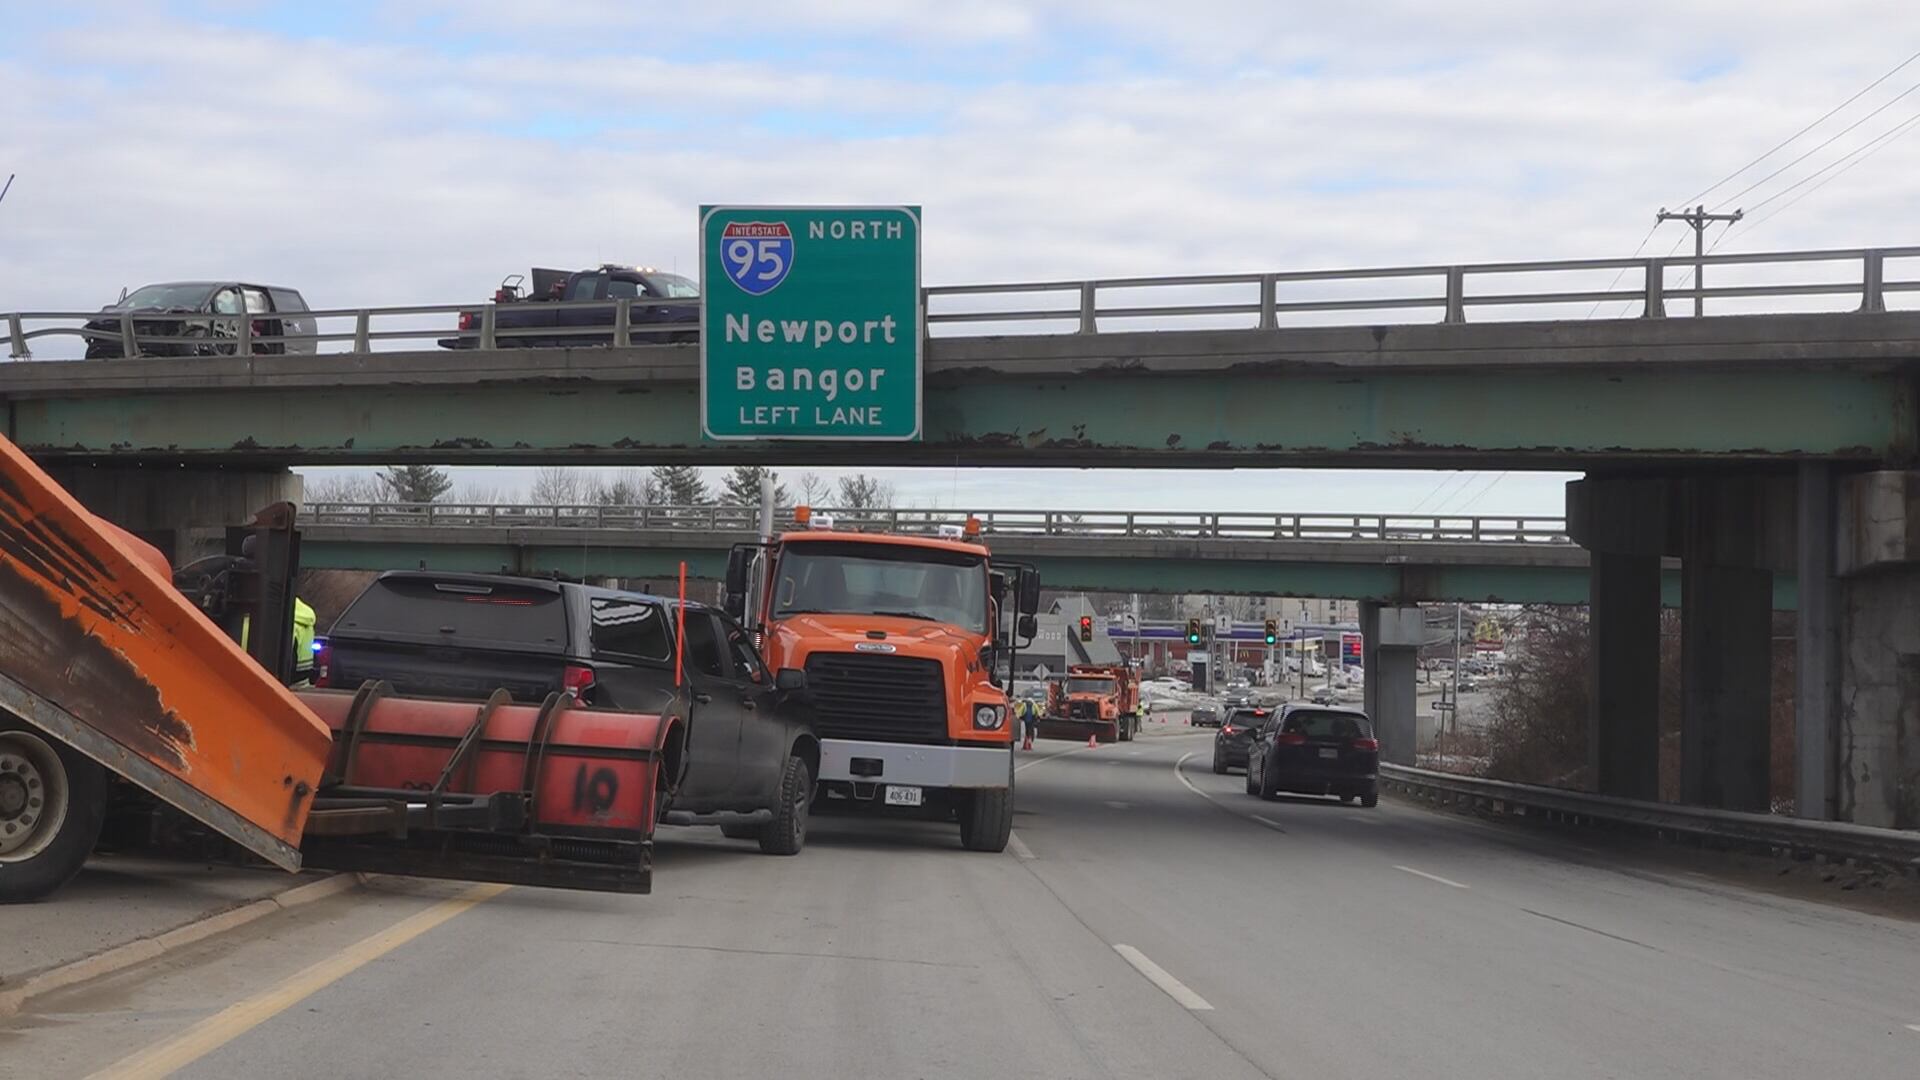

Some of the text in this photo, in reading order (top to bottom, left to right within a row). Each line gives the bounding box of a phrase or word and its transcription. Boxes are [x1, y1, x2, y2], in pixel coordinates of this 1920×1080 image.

[731, 225, 783, 237] INTERSTATE
[809, 221, 901, 240] NORTH
[728, 240, 784, 280] 95
[725, 313, 896, 349] Newport
[736, 366, 885, 402] Bangor
[740, 406, 882, 425] LEFT LANE
